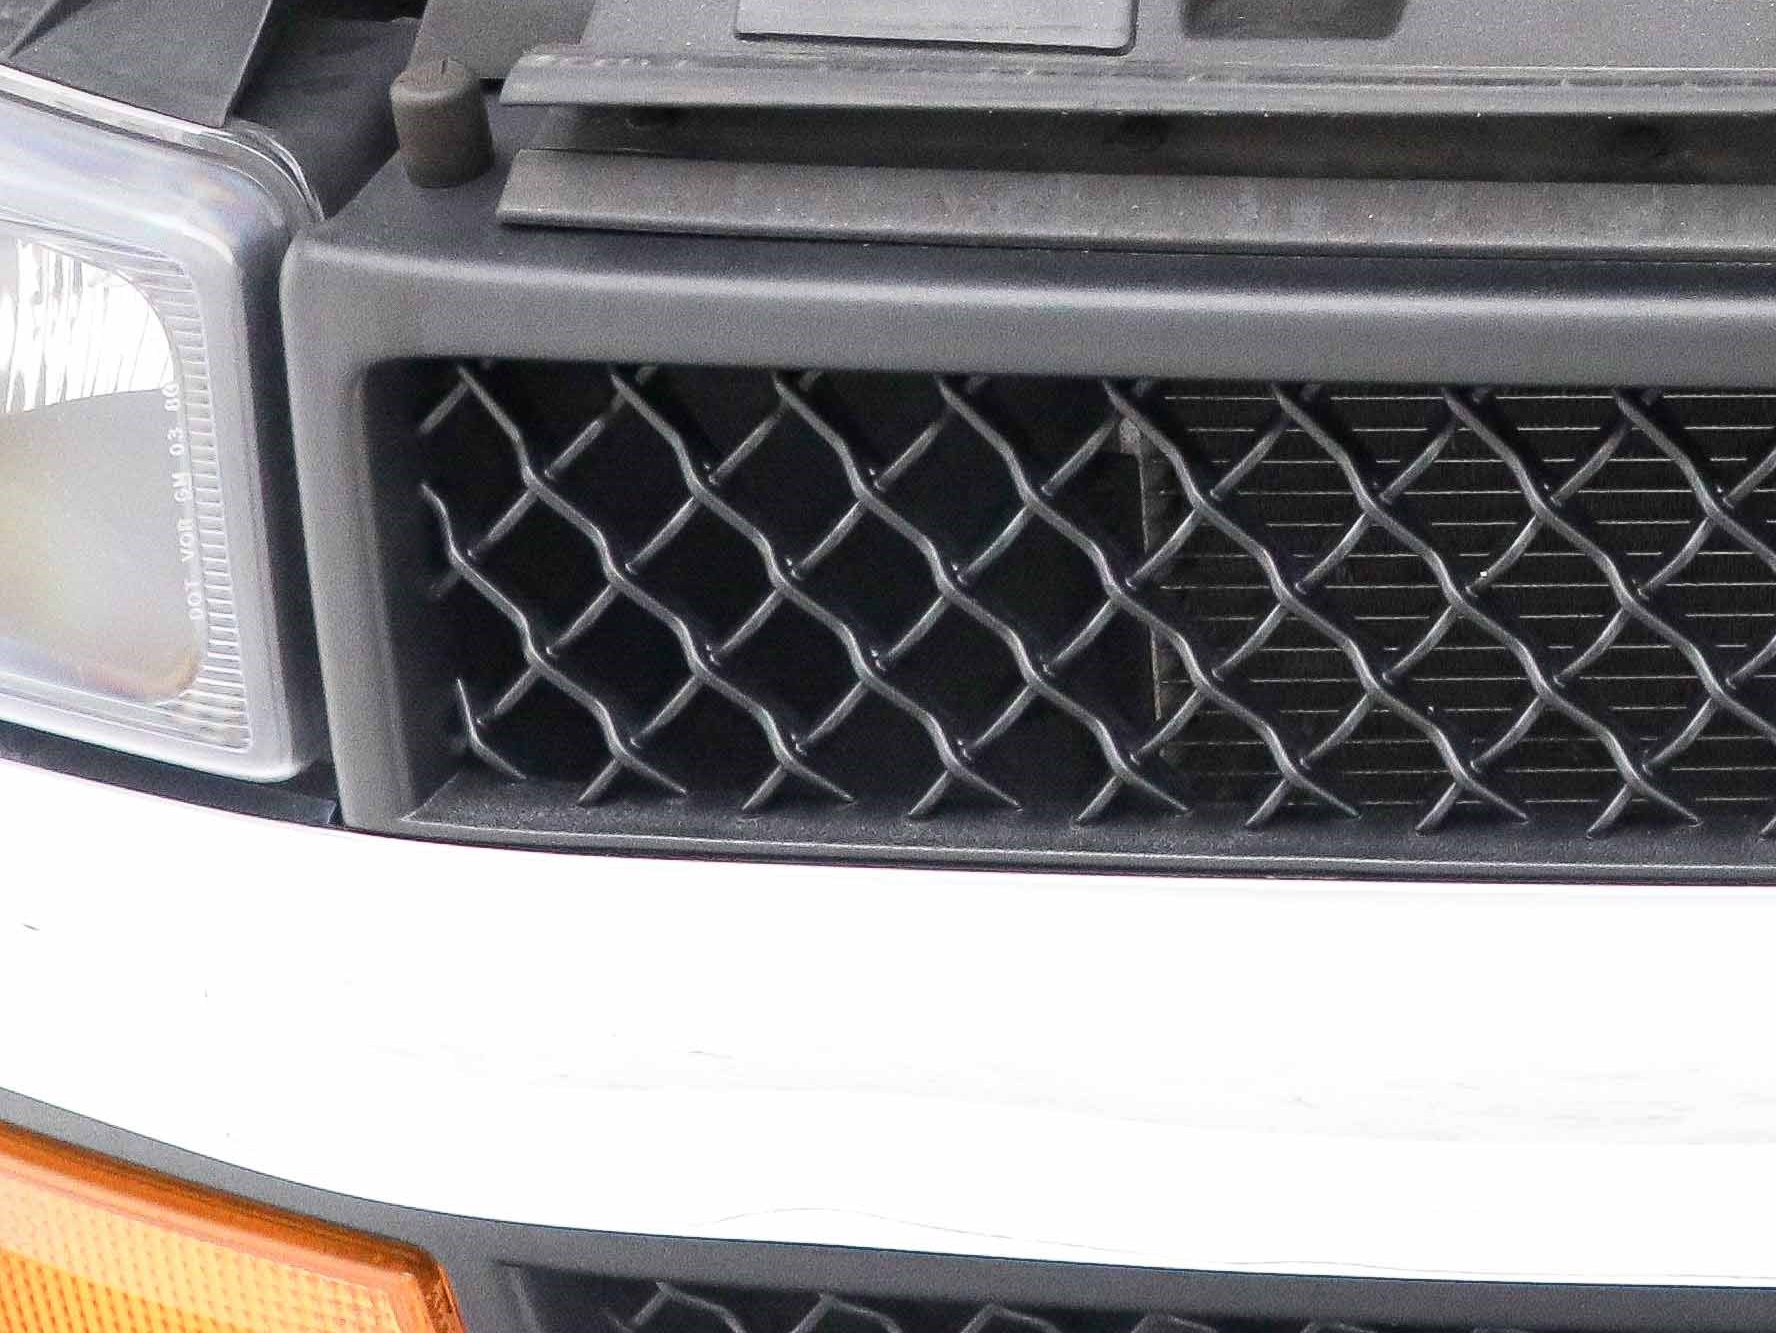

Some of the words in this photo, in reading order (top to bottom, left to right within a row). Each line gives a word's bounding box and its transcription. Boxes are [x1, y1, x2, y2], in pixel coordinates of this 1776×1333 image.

[171, 472, 194, 503] GM
[177, 518, 195, 563] VOR
[183, 578, 203, 621] DOT
